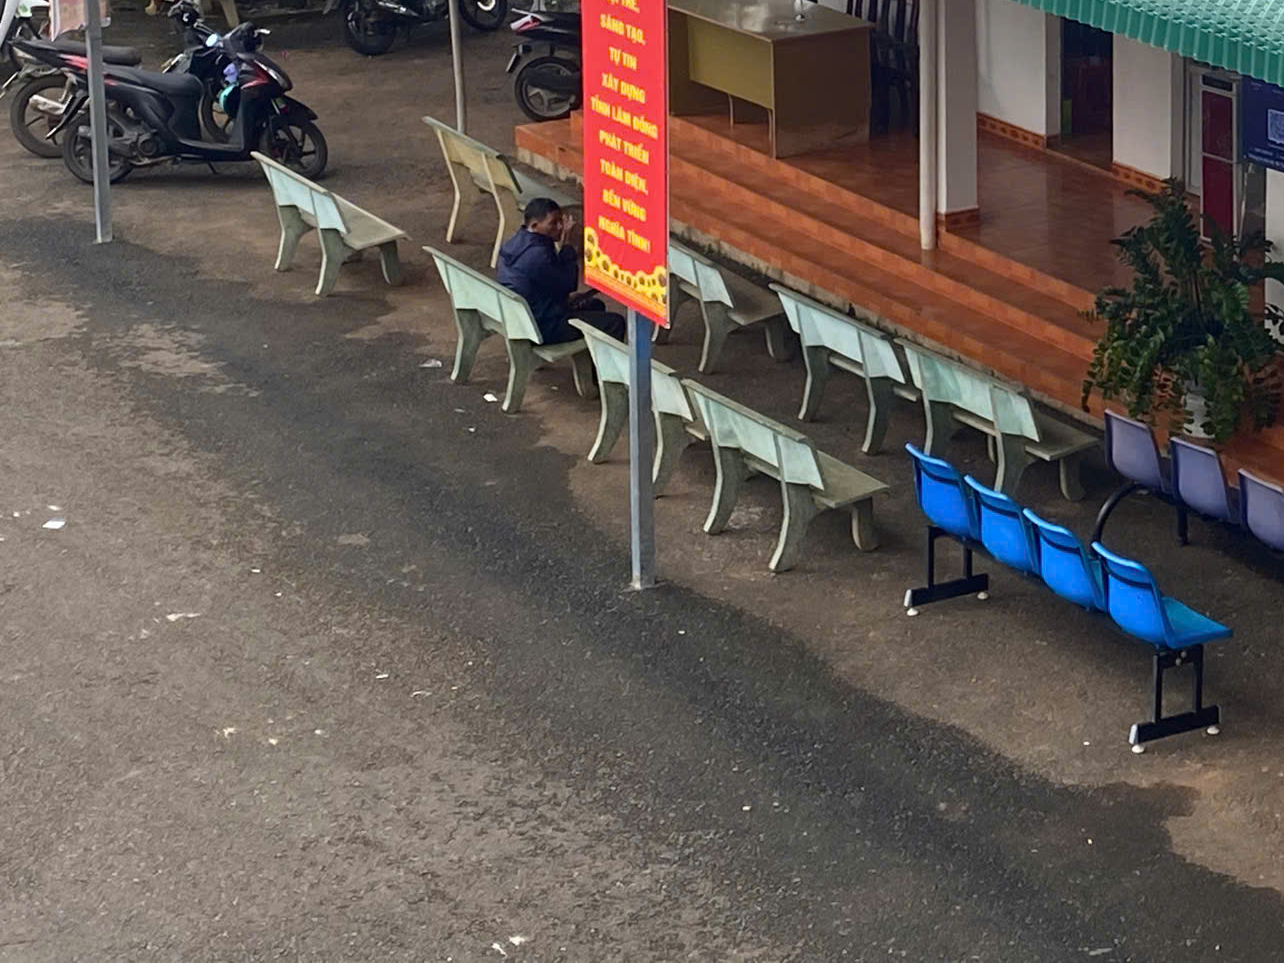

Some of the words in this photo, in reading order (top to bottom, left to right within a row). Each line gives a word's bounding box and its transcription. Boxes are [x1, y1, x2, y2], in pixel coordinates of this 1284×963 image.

[600, 13, 624, 36] SÁNG
[609, 46, 621, 66] TỰ
[622, 52, 637, 70] TIN
[601, 71, 618, 93] XÂY
[599, 129, 622, 151] PHÁT
